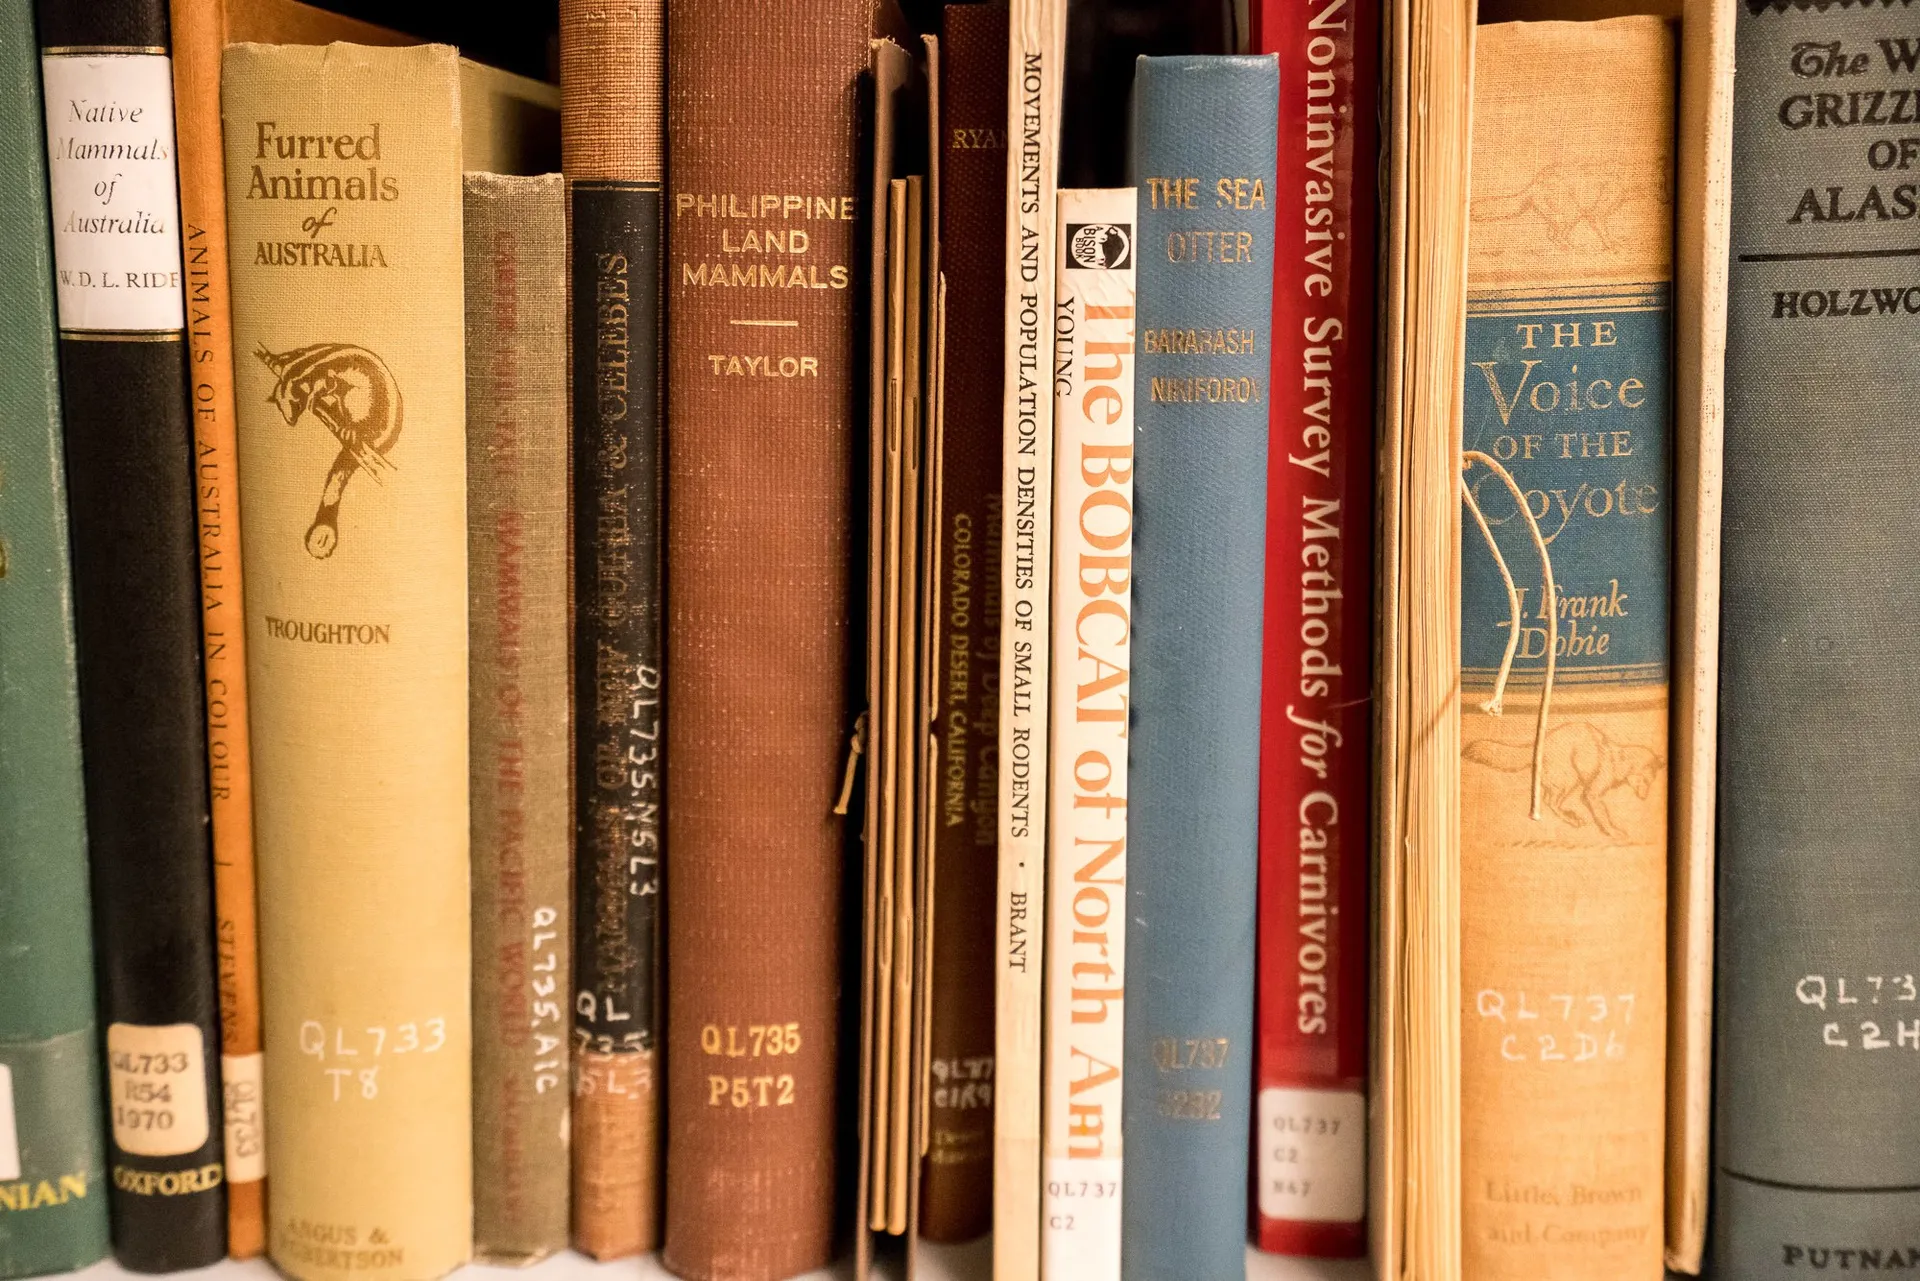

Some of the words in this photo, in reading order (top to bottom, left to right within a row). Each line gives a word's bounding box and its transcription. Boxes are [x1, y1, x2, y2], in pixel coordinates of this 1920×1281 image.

[1791, 41, 1870, 78] The
[68, 99, 143, 123] Native
[56, 137, 169, 160] Mammals
[255, 121, 381, 160] Furred
[1020, 52, 1042, 214] MOVEMENTS
[1302, 0, 1347, 298] Noninvasive
[1868, 138, 1920, 170] OF
[94, 173, 123, 205] of
[246, 165, 400, 201] Animals
[1147, 177, 1199, 210] THE
[1217, 178, 1266, 210] SEA
[63, 210, 165, 234] Australia
[301, 207, 337, 236] of
[676, 193, 859, 221] PHILIPPINE
[1786, 184, 1920, 225] ALAS
[253, 242, 388, 269] AUSTRALIA
[721, 230, 809, 254] LAND
[1020, 225, 1039, 282] AND
[1075, 238, 1084, 260] BOOK
[1083, 228, 1096, 262] BISON
[1168, 232, 1253, 264] OTTER
[187, 223, 214, 364] ANIMALS
[682, 264, 849, 290] MAMMALS
[599, 252, 630, 421] CELEBES
[1055, 296, 1075, 398] YOUNG
[1517, 321, 1618, 350] THE
[708, 355, 819, 378] TAYLOR
[1017, 295, 1038, 455] POPULATION
[1082, 291, 1134, 425] The
[195, 384, 216, 423] OF
[1289, 316, 1344, 479] Survey
[1472, 360, 1645, 426] Voice
[601, 435, 629, 470] &
[1493, 433, 1542, 460] OF
[1555, 431, 1633, 458] THE
[198, 440, 223, 612] AUSTRALIA
[1473, 471, 1661, 546] Coyote
[1015, 466, 1035, 590] DENSITIES
[951, 513, 973, 629] COLORADO
[1074, 442, 1134, 738] BOBCAT
[1300, 495, 1344, 698] Methods
[1537, 578, 1628, 620] Frank
[265, 617, 390, 646] TROUGHTON
[1014, 601, 1033, 632] OF
[206, 631, 226, 661] IN
[1516, 620, 1611, 660] Dobie
[1012, 641, 1031, 717] SMALL
[208, 679, 231, 801] COLOUR
[1287, 704, 1343, 782] for
[499, 739, 523, 795] THE
[945, 710, 968, 828] CALIFORNIA
[1011, 728, 1030, 838] RODENTS
[1073, 749, 1127, 820] of
[500, 807, 525, 931] PACIFIC
[1071, 837, 1126, 1025] North
[1298, 791, 1338, 1036] Carnivores
[1009, 892, 1028, 973] BRANT
[1477, 989, 1635, 1025] QL737
[1795, 974, 1917, 1010] QL73
[299, 1018, 446, 1056] QL733
[701, 1022, 801, 1057] QL735
[1501, 1030, 1627, 1061] C2D6
[113, 1052, 188, 1075] QL733
[324, 1066, 381, 1102] T8
[708, 1074, 796, 1108] P5T2
[116, 1108, 174, 1130] 1970
[1068, 1045, 1121, 1160] Am
[1273, 1115, 1341, 1135] QL737
[1273, 1146, 1298, 1165] C2
[0, 1170, 87, 1211] NIAN
[113, 1162, 223, 1196] OXFORD
[1048, 1182, 1116, 1199] QL737
[1571, 1182, 1642, 1204] Brown
[285, 1219, 357, 1245] ANGUS
[368, 1225, 391, 1245] &
[1050, 1215, 1075, 1231] C2
